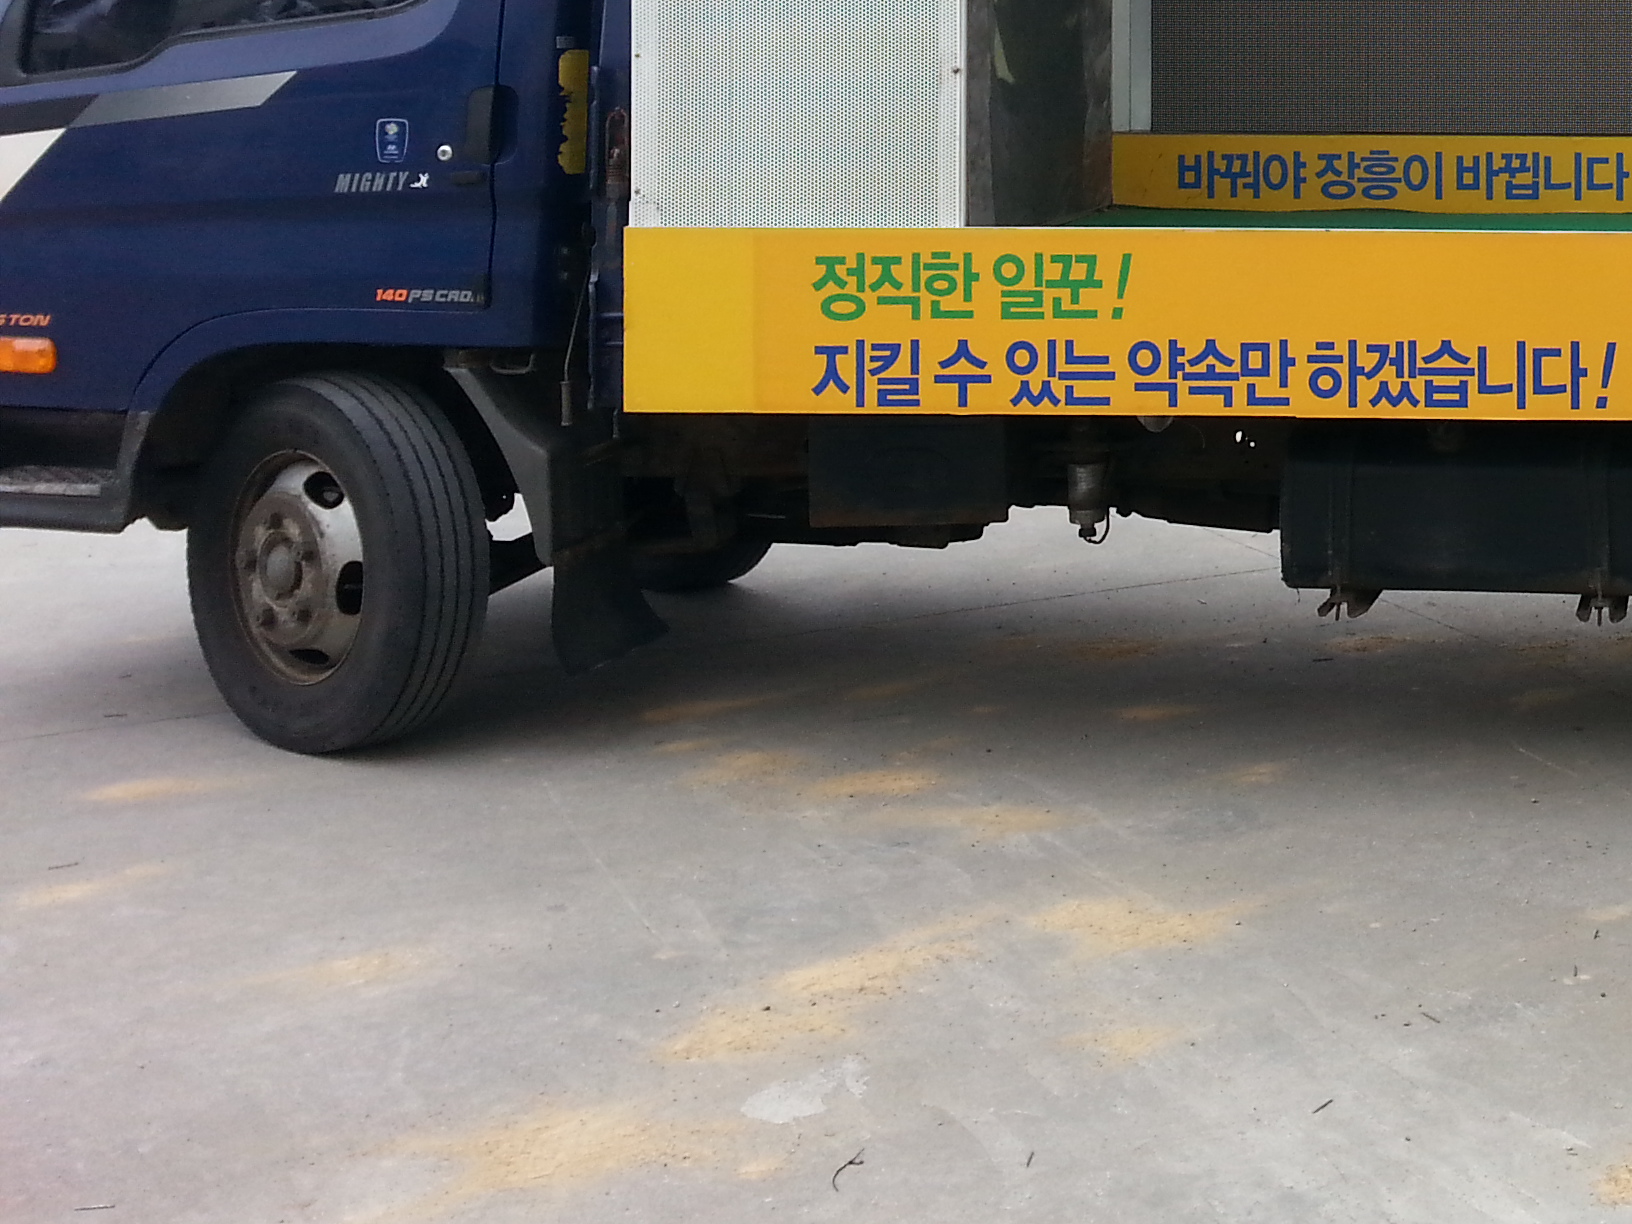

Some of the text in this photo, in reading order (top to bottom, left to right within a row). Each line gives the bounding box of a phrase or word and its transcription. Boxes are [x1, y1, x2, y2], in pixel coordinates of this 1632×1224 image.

[334, 171, 409, 193] MIGHTY
[1177, 151, 1306, 199] 바꿔야
[1314, 150, 1442, 200] 장흥이
[1456, 151, 1630, 200] 바뀝니다
[810, 252, 1133, 321] 정직한 일꾼!
[811, 339, 1617, 411] 지킬 수 있는 약속만 하겠습니다!
